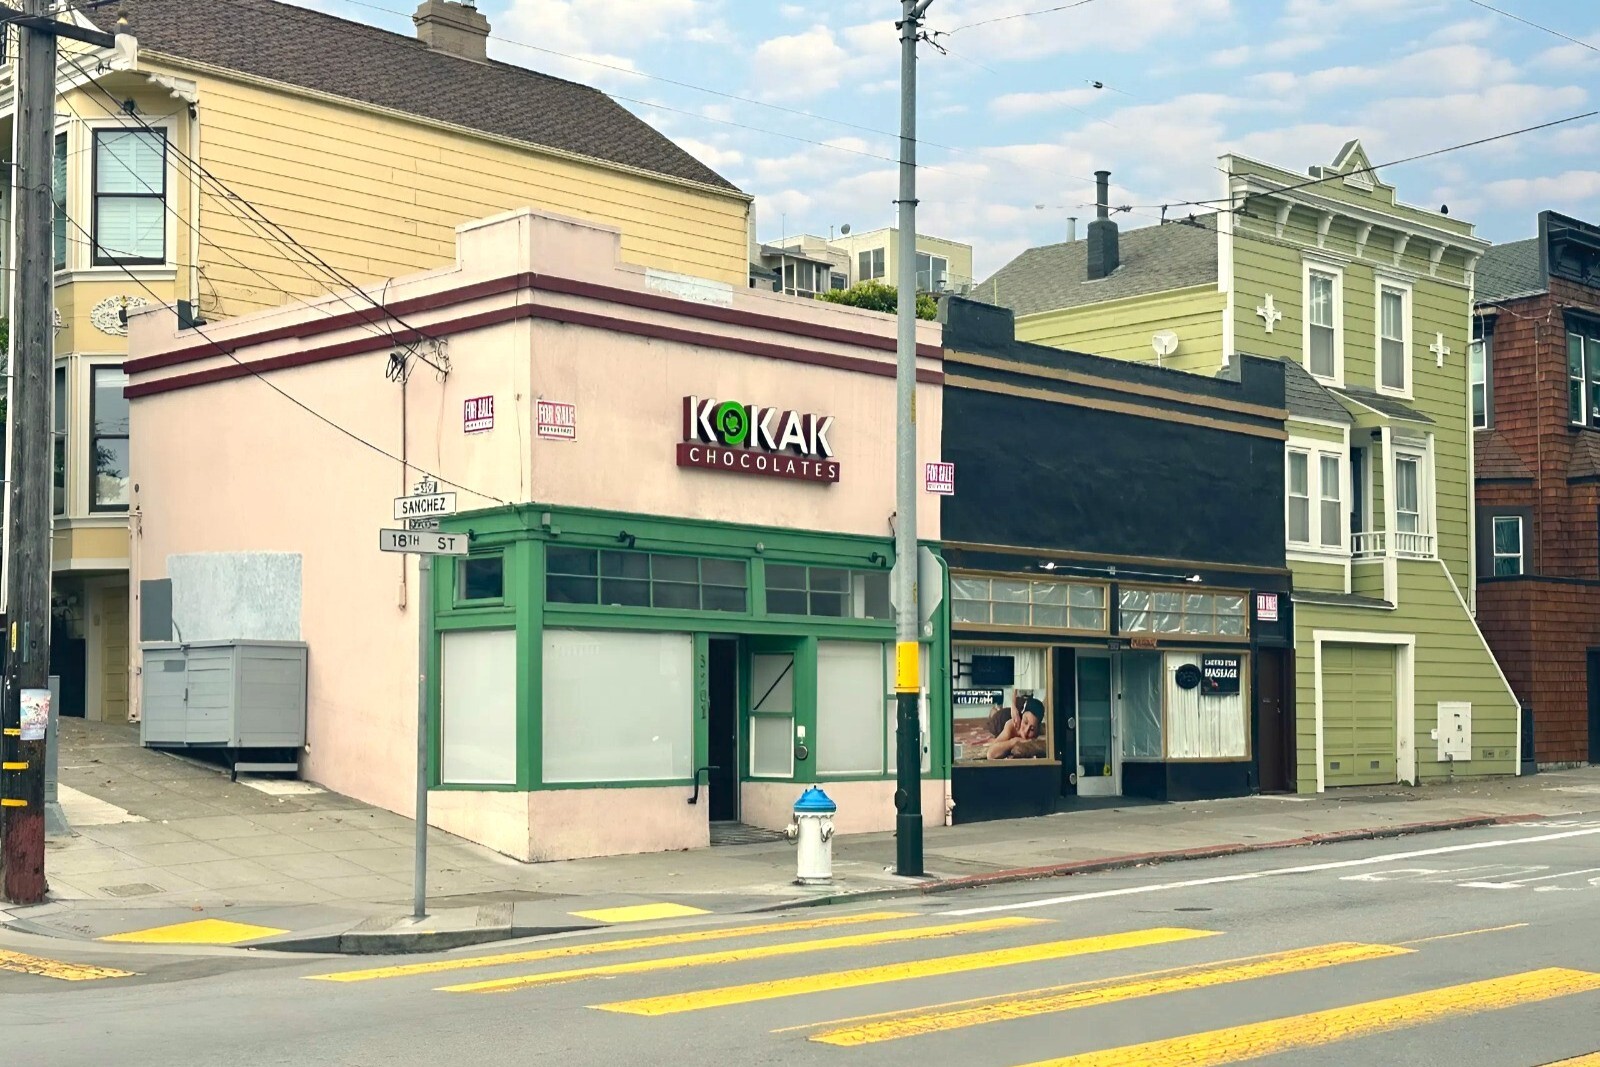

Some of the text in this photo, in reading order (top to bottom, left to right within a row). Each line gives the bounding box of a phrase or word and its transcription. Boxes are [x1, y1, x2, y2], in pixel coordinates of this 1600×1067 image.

[538, 403, 575, 426] FOR SALE
[683, 395, 835, 457] KOKAK
[689, 447, 836, 479] CHOCOLATES
[402, 497, 446, 514] SANCHEZ
[392, 534, 456, 551] 18TH ST
